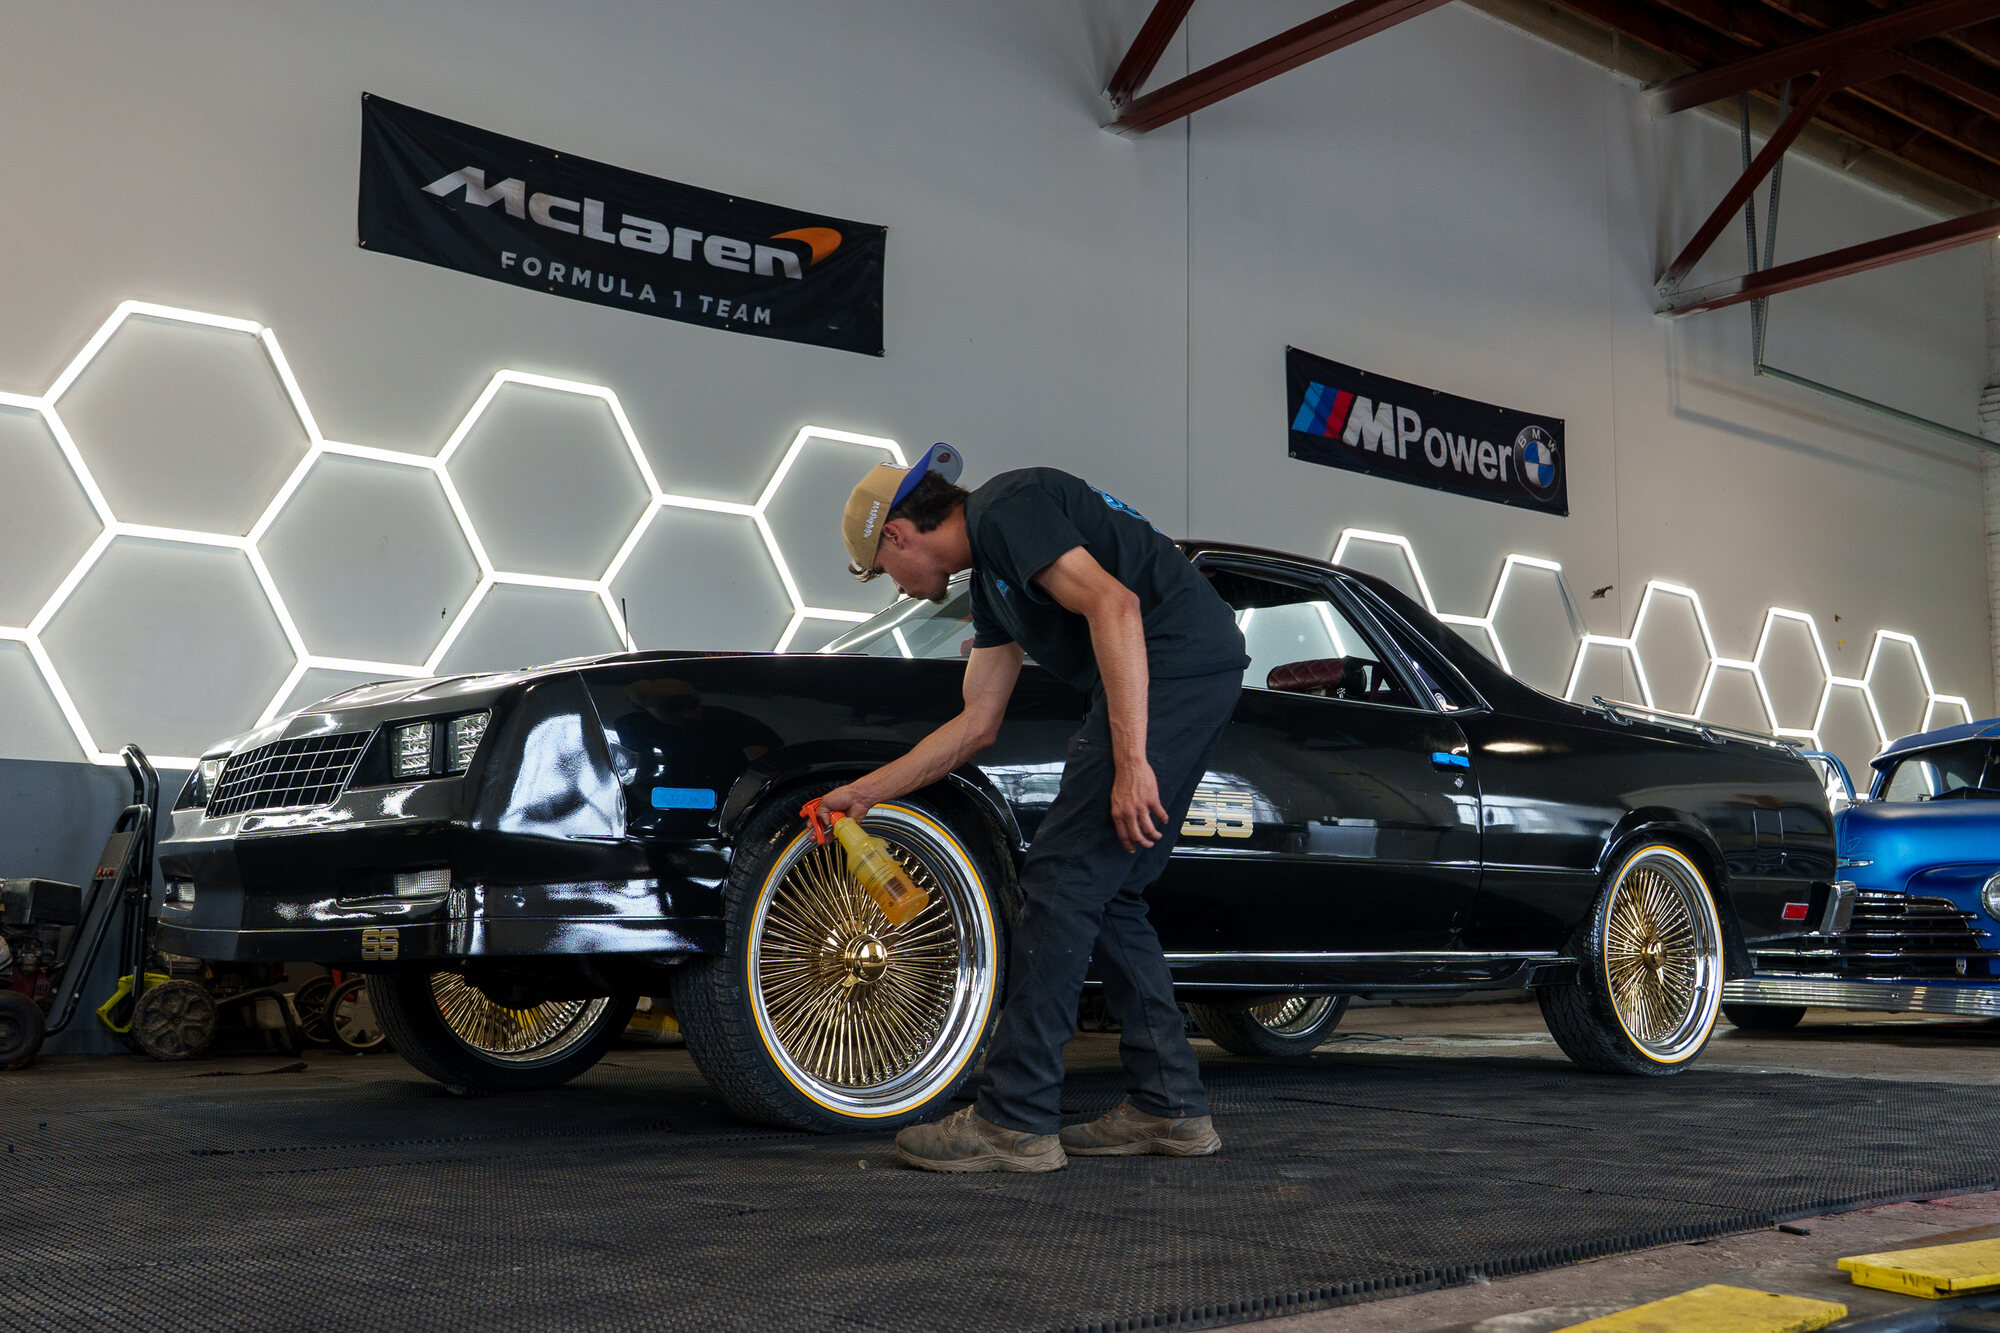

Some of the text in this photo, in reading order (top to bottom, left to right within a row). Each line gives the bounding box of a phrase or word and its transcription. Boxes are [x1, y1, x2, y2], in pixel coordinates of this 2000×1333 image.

[420, 165, 804, 281] McLaren
[500, 250, 773, 325] FORMULA 1 TEAM
[1517, 428, 1556, 453] BMW
[361, 928, 399, 961] SS
